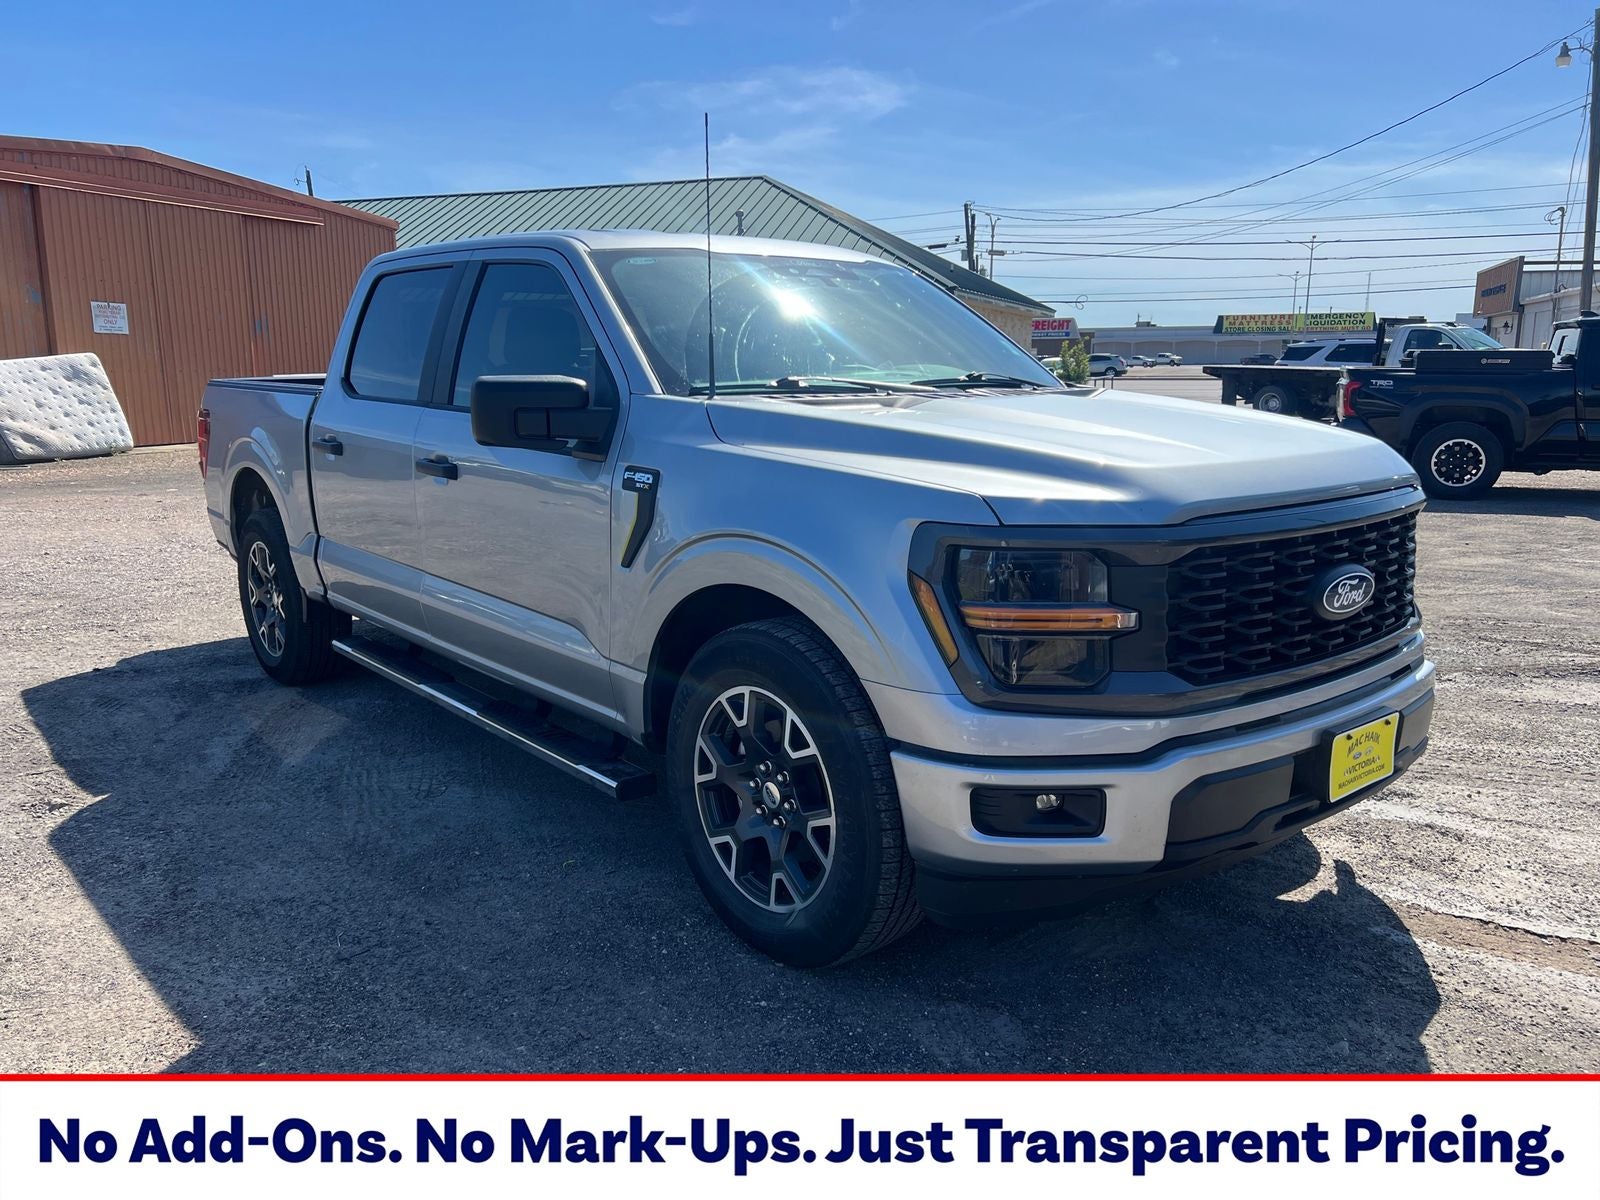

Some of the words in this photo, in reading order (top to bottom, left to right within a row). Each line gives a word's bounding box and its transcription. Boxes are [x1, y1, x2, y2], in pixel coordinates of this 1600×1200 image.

[624, 471, 653, 483] F-150
[1333, 578, 1366, 608] Ford
[1348, 758, 1377, 774] VICTORIA
